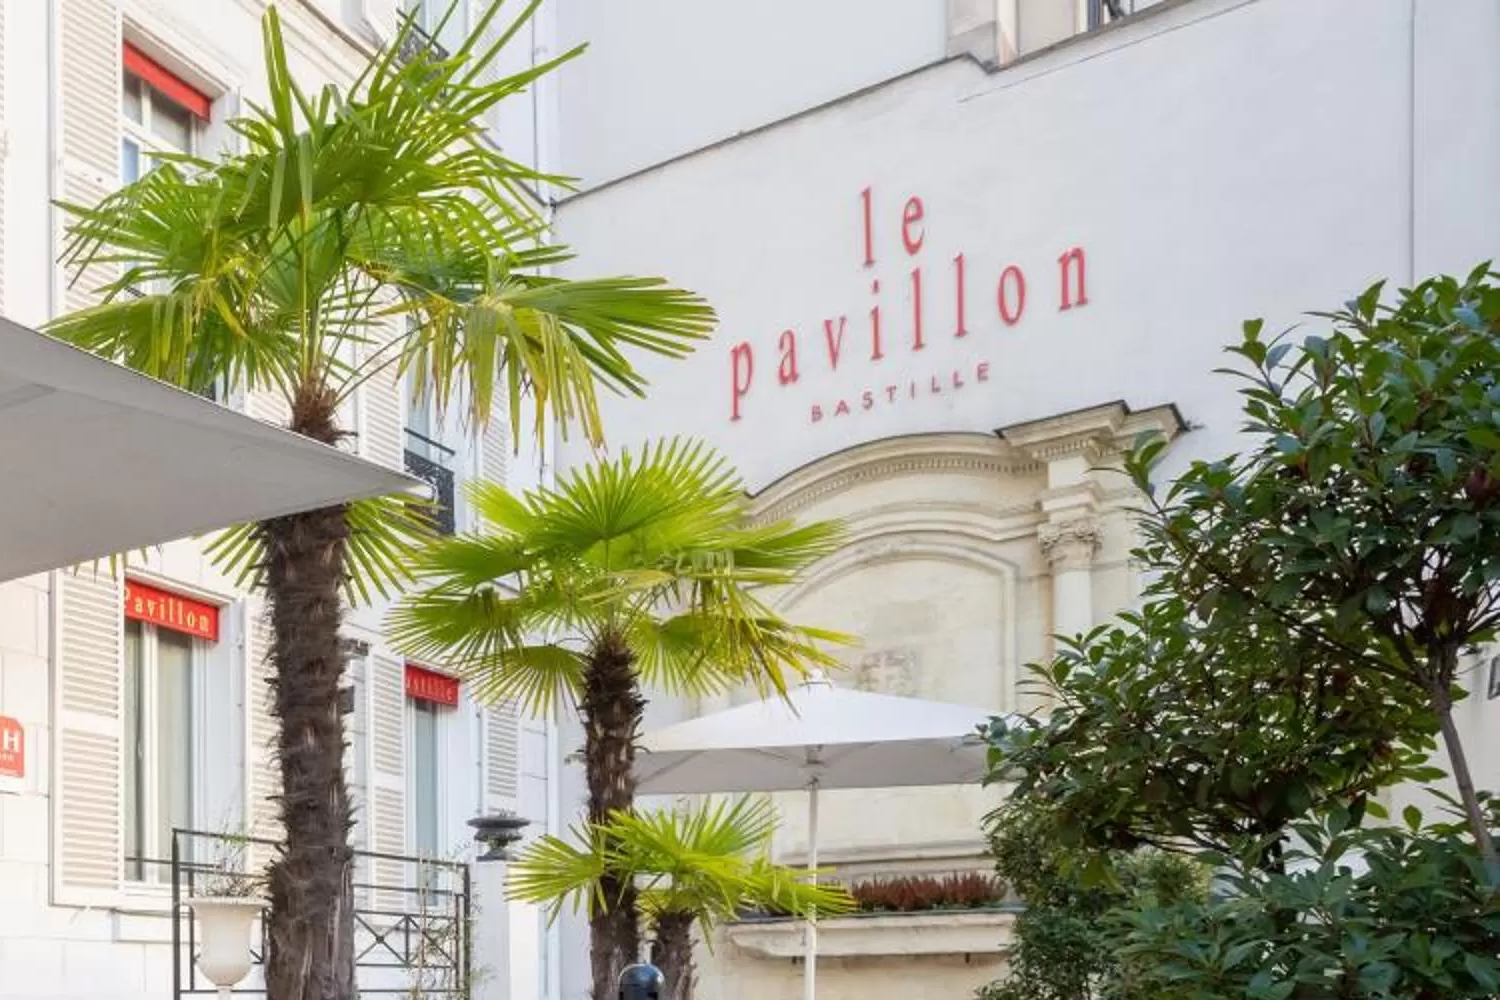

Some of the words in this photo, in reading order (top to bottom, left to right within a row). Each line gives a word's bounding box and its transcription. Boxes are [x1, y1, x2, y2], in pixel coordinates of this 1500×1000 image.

[859, 186, 926, 268] le
[729, 245, 1090, 422] pavillon
[810, 362, 992, 424] BASTILLE
[3, 728, 19, 752] H
